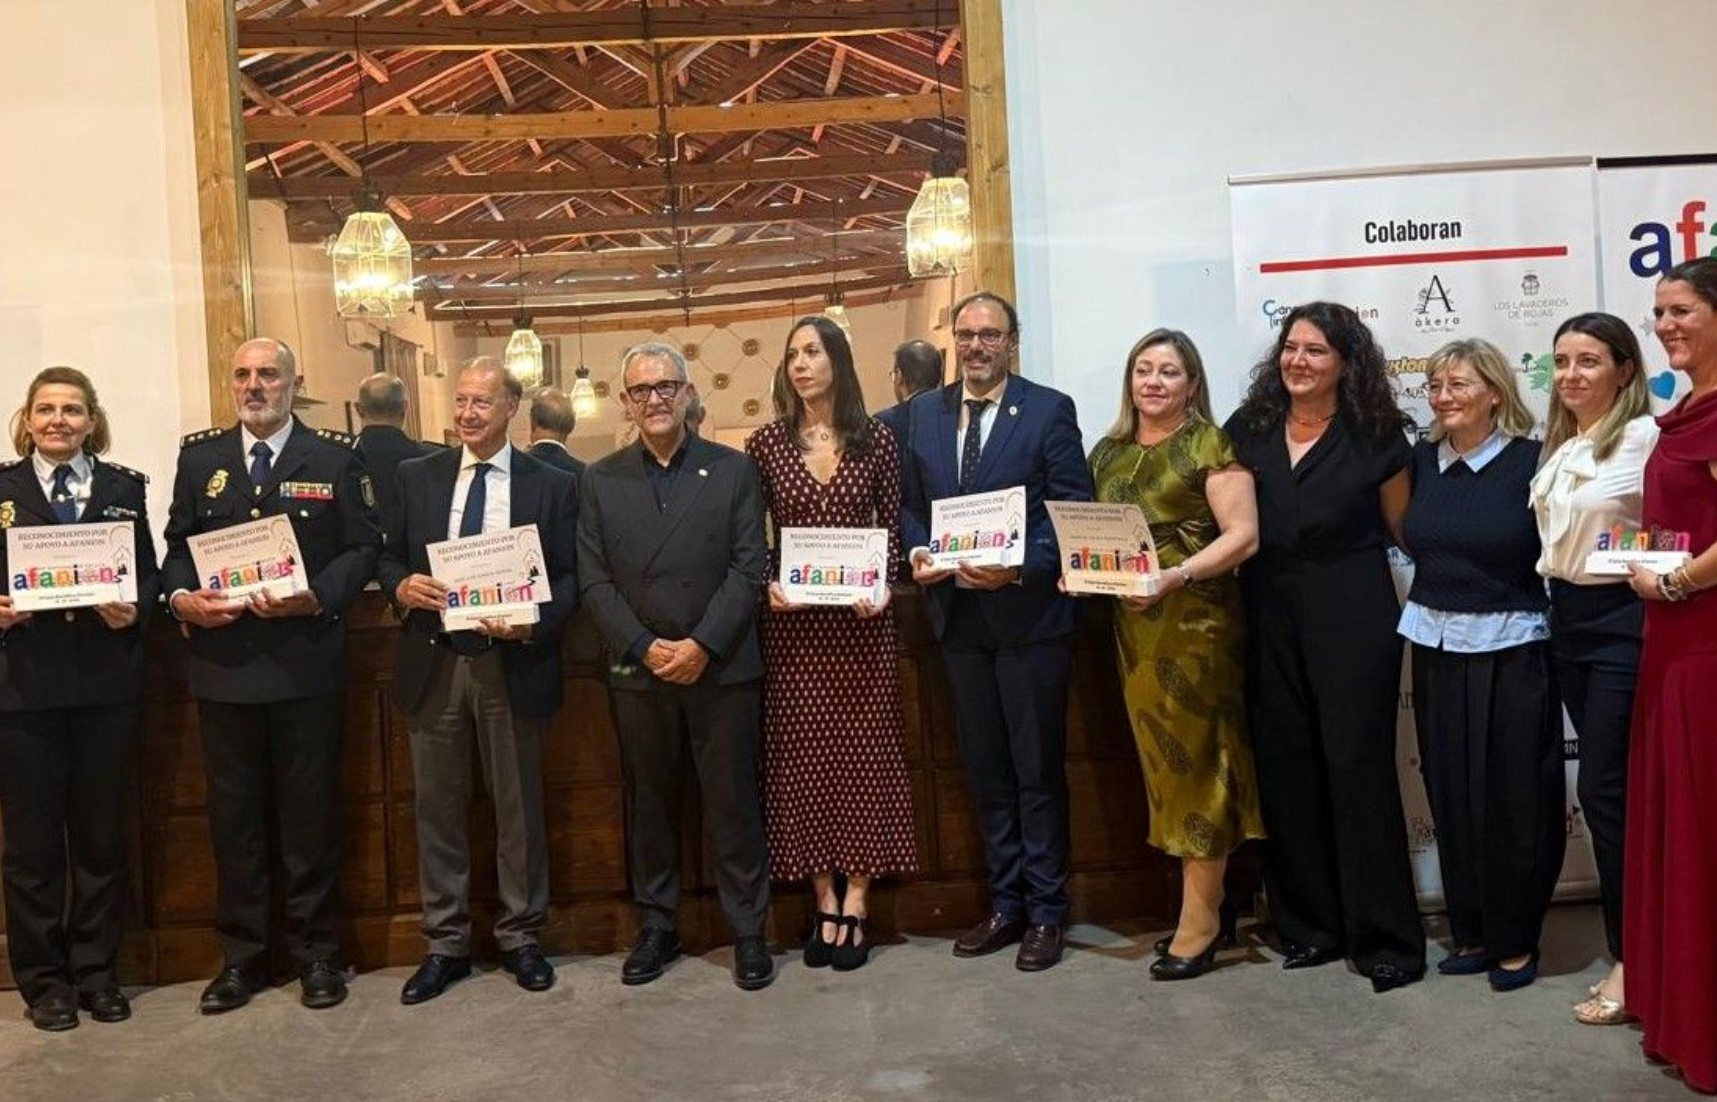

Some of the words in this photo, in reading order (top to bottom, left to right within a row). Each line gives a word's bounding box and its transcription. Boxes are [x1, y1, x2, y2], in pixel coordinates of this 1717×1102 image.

[1365, 219, 1462, 243] Colaboran
[1494, 302, 1511, 311] LOS
[1512, 299, 1569, 309] LAVADEROS
[1508, 311, 1520, 319] DE
[1524, 309, 1553, 318] ROJAS
[18, 530, 90, 541] RECONOCIMIENTO
[91, 529, 108, 537] POR
[256, 525, 268, 534] POR
[35, 541, 59, 549] APOYO
[438, 539, 499, 555] RECONOCIMIENTO
[499, 535, 515, 544] POR
[929, 530, 1006, 554] afanion
[454, 551, 476, 561] APOYO
[483, 544, 515, 555] AFANION
[1070, 547, 1150, 575] afanion
[13, 564, 113, 590] afanion
[447, 583, 533, 608] afanion
